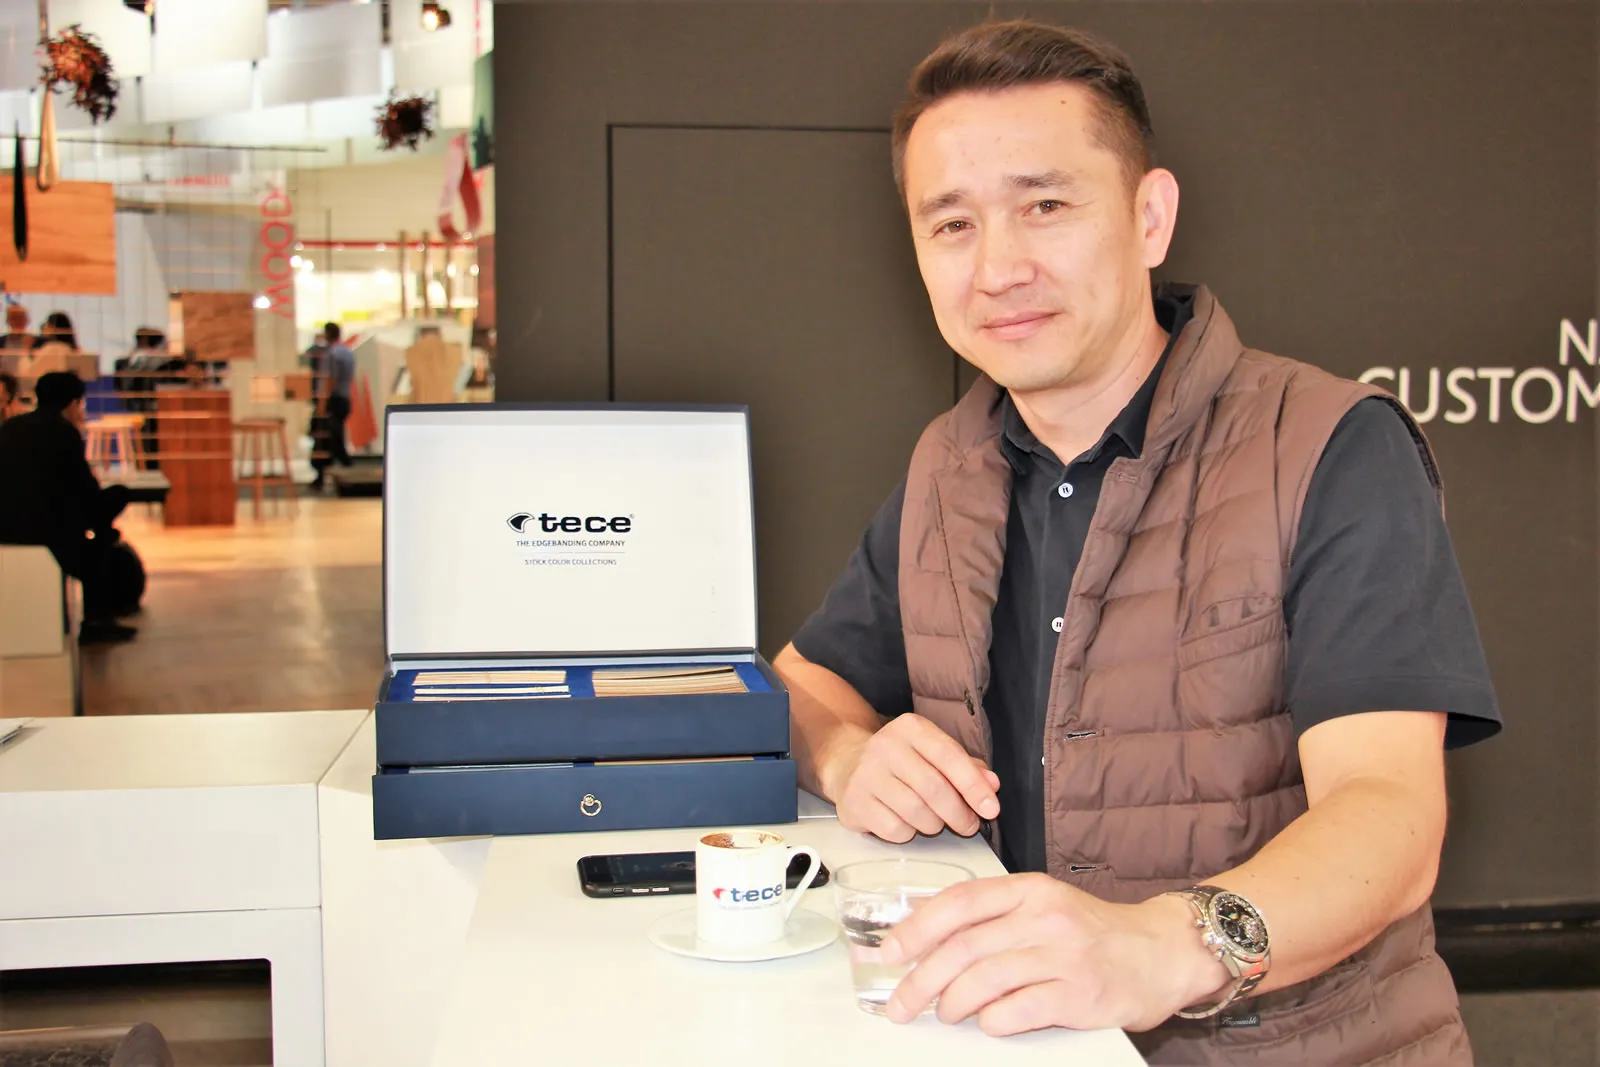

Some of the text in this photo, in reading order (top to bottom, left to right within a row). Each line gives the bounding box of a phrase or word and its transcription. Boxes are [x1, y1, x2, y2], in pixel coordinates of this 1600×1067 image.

[260, 187, 294, 318] MOOD
[1559, 318, 1600, 366] N
[730, 883, 783, 902] tece
